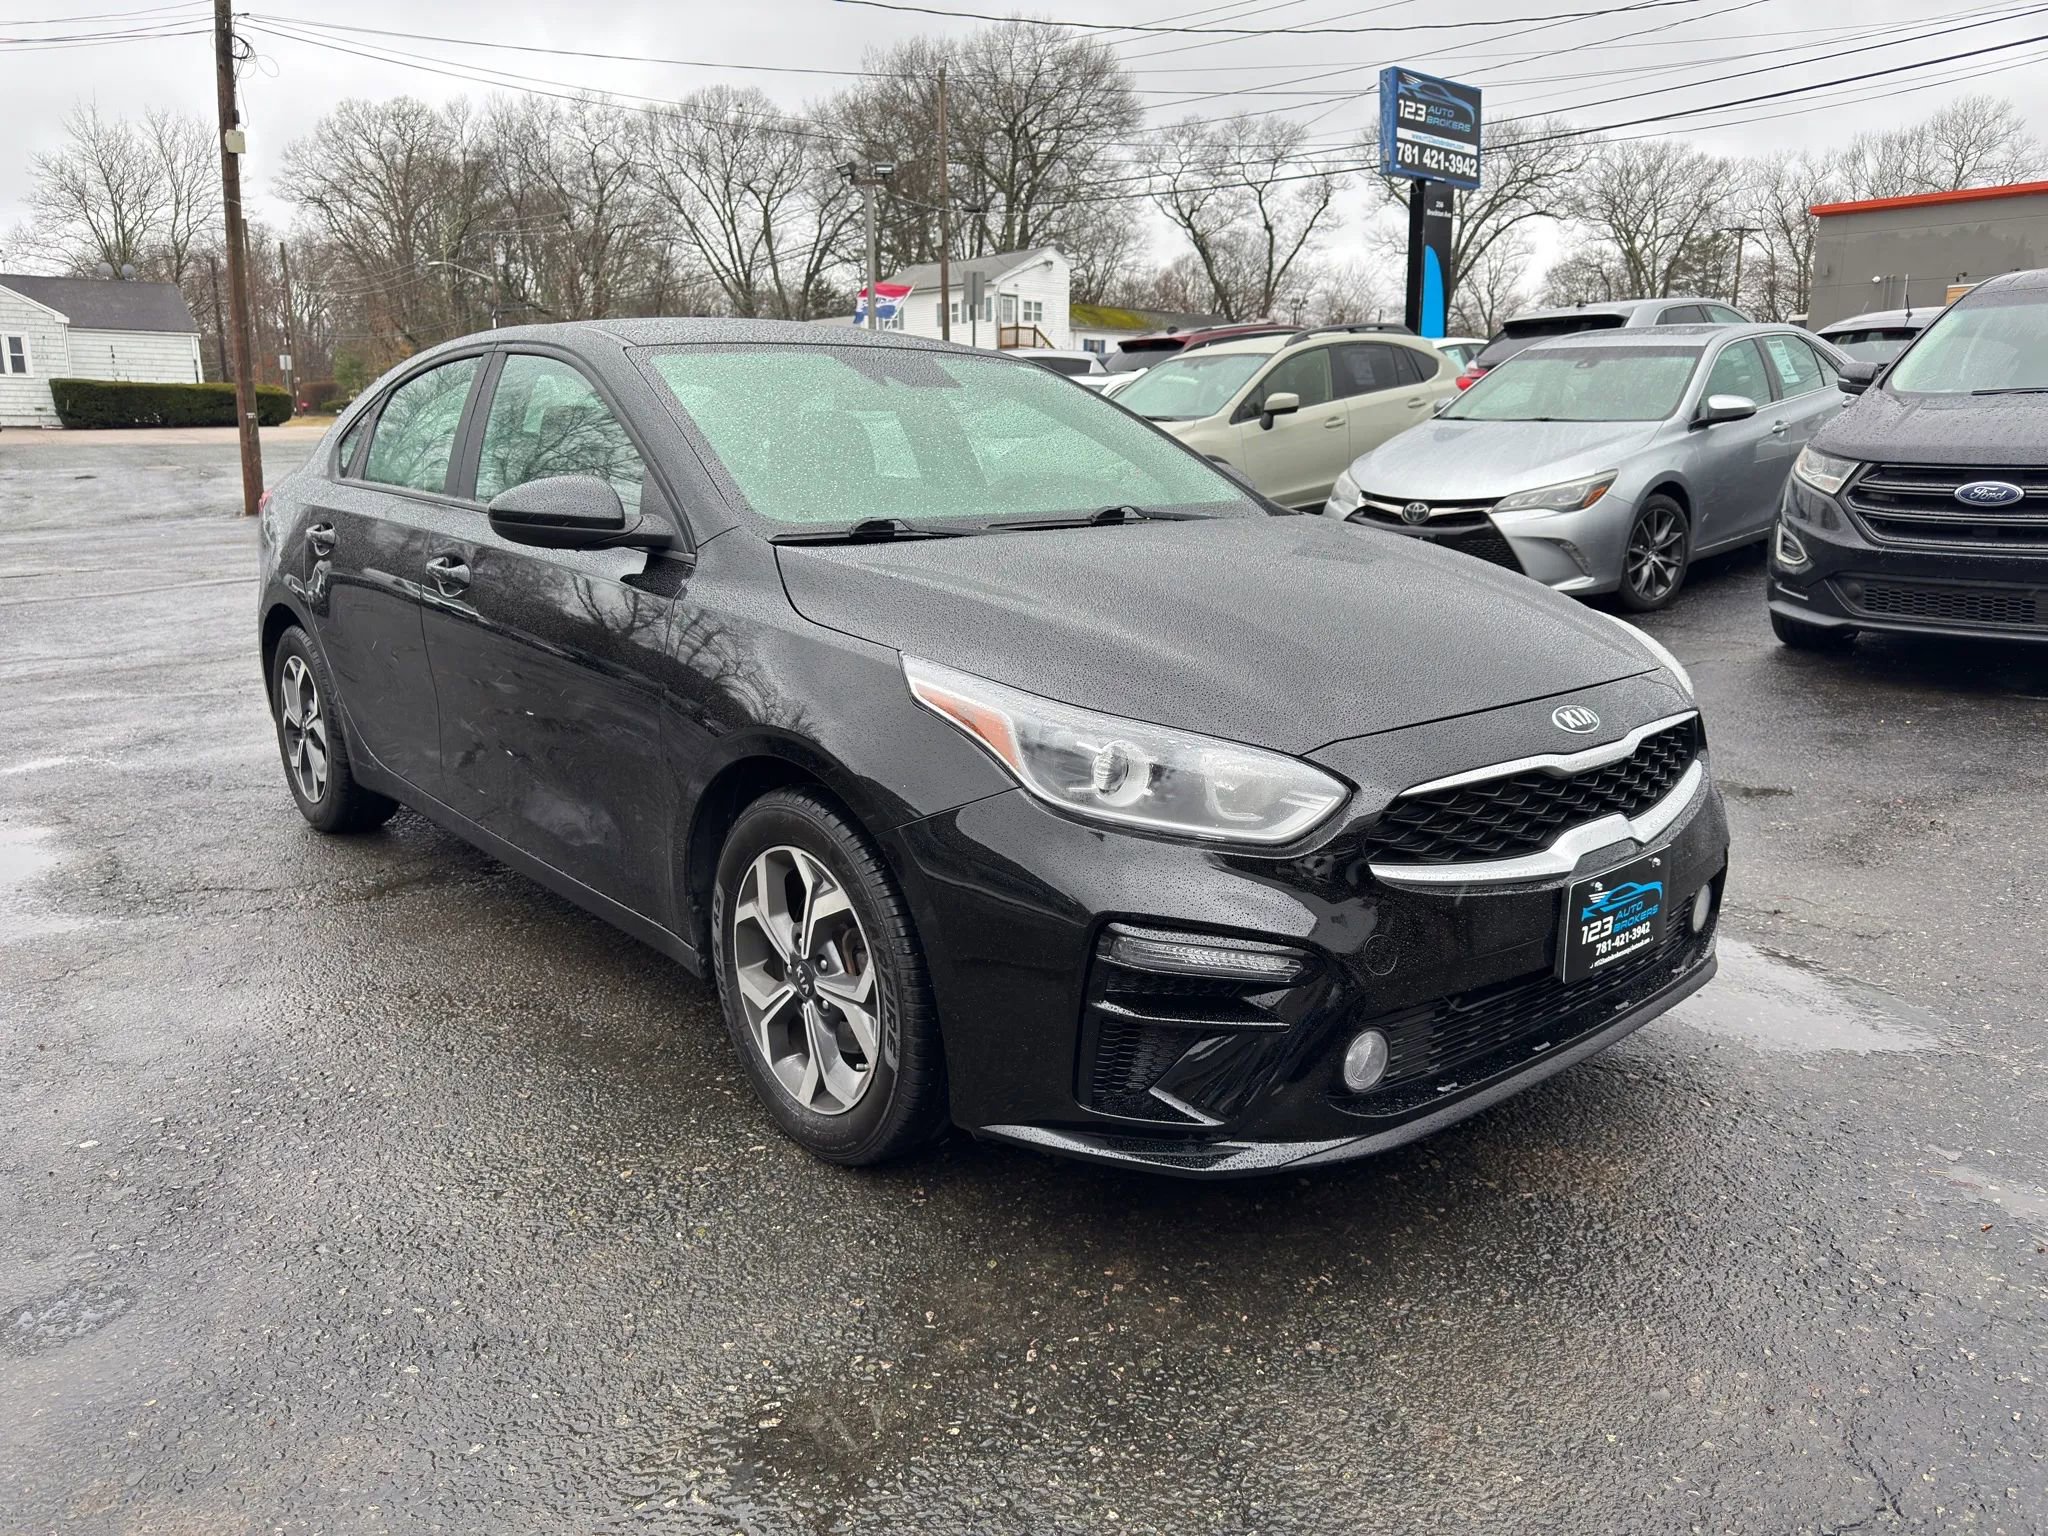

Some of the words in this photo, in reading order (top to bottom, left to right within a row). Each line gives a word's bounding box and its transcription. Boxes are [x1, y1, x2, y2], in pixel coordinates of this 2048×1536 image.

[1398, 99, 1427, 122] 123
[1428, 105, 1455, 118] AUTO
[1426, 116, 1472, 133] BROKERS
[1396, 141, 1419, 165] 781
[1422, 148, 1478, 178] 421-3942
[1969, 486, 2008, 500] Ford
[1557, 707, 1598, 729] KIA
[1613, 904, 1659, 933] BROKERS
[1615, 901, 1644, 920] AUTO
[1581, 916, 1614, 945] 123
[1595, 921, 1651, 956] 781-421-3942
[796, 964, 810, 994] KIA
